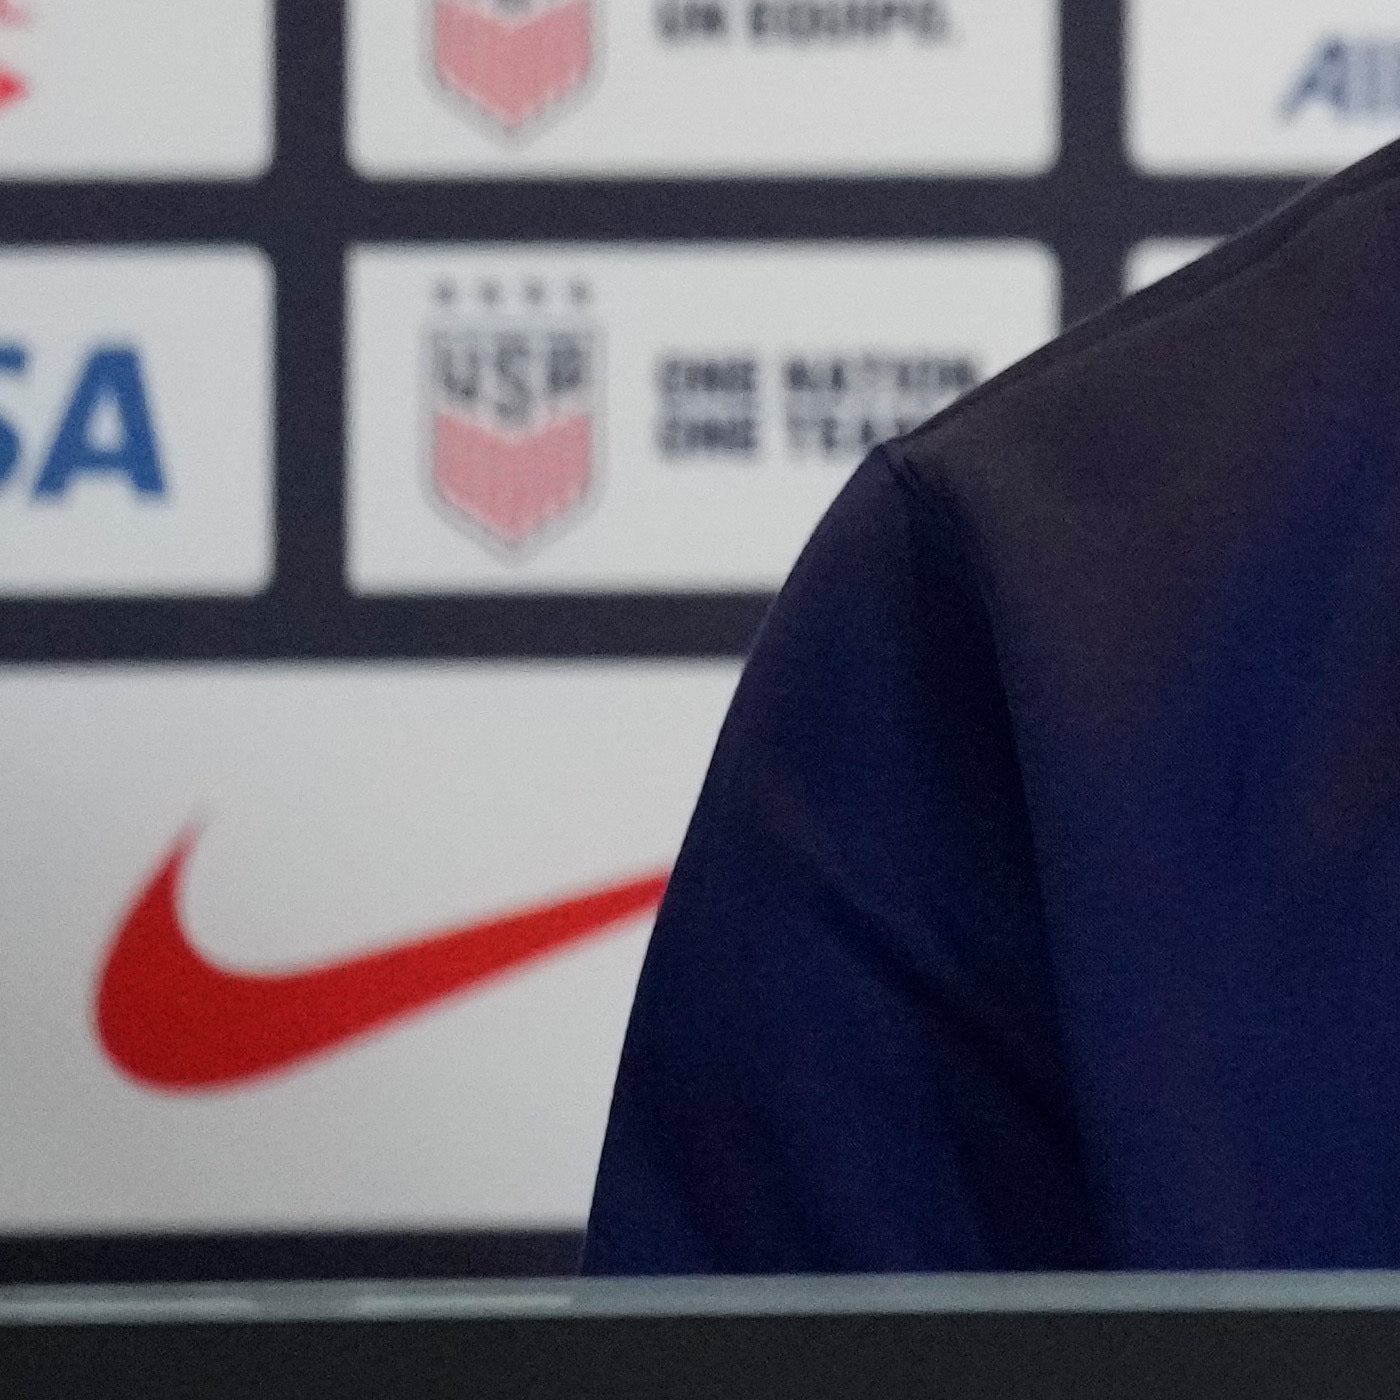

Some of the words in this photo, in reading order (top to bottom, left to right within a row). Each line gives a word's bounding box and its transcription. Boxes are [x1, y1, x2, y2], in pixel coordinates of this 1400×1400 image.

[656, 1, 729, 44] UN
[656, 356, 759, 397] ONE
[657, 414, 759, 457] ONE
